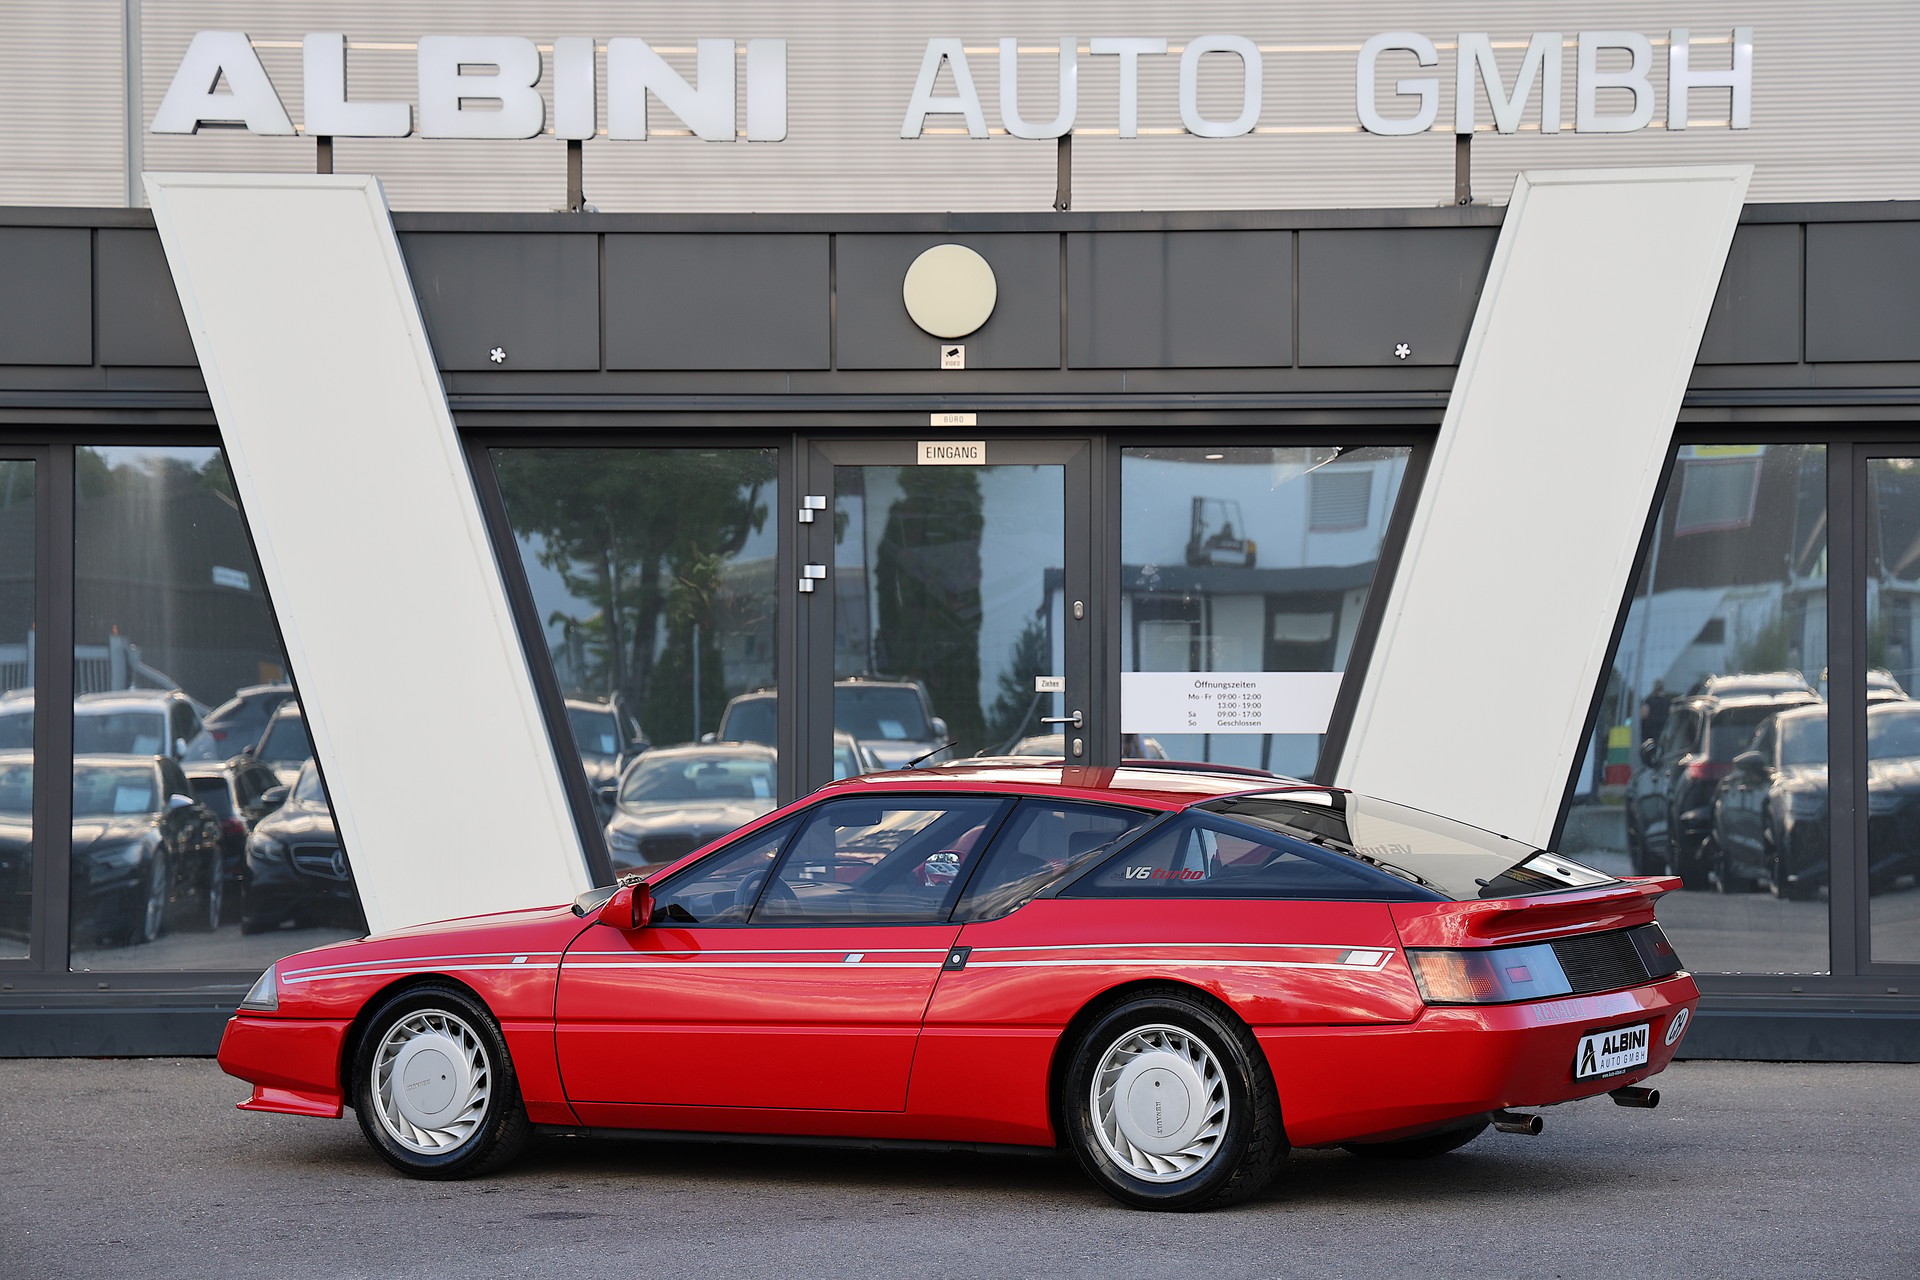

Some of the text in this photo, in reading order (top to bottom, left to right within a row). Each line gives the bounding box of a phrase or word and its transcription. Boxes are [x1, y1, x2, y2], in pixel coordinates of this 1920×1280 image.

[150, 27, 1755, 141] ALBINI AUTO GMBH
[943, 414, 964, 423] BÜRO
[926, 446, 978, 459] EINGANG
[1194, 680, 1256, 689] Öffnungszeiten
[1217, 719, 1262, 727] Geschlossen
[1601, 1029, 1646, 1056] ALBINI
[1600, 1050, 1645, 1069] AUTO GMBH
[1155, 1101, 1163, 1135] RENAULT
